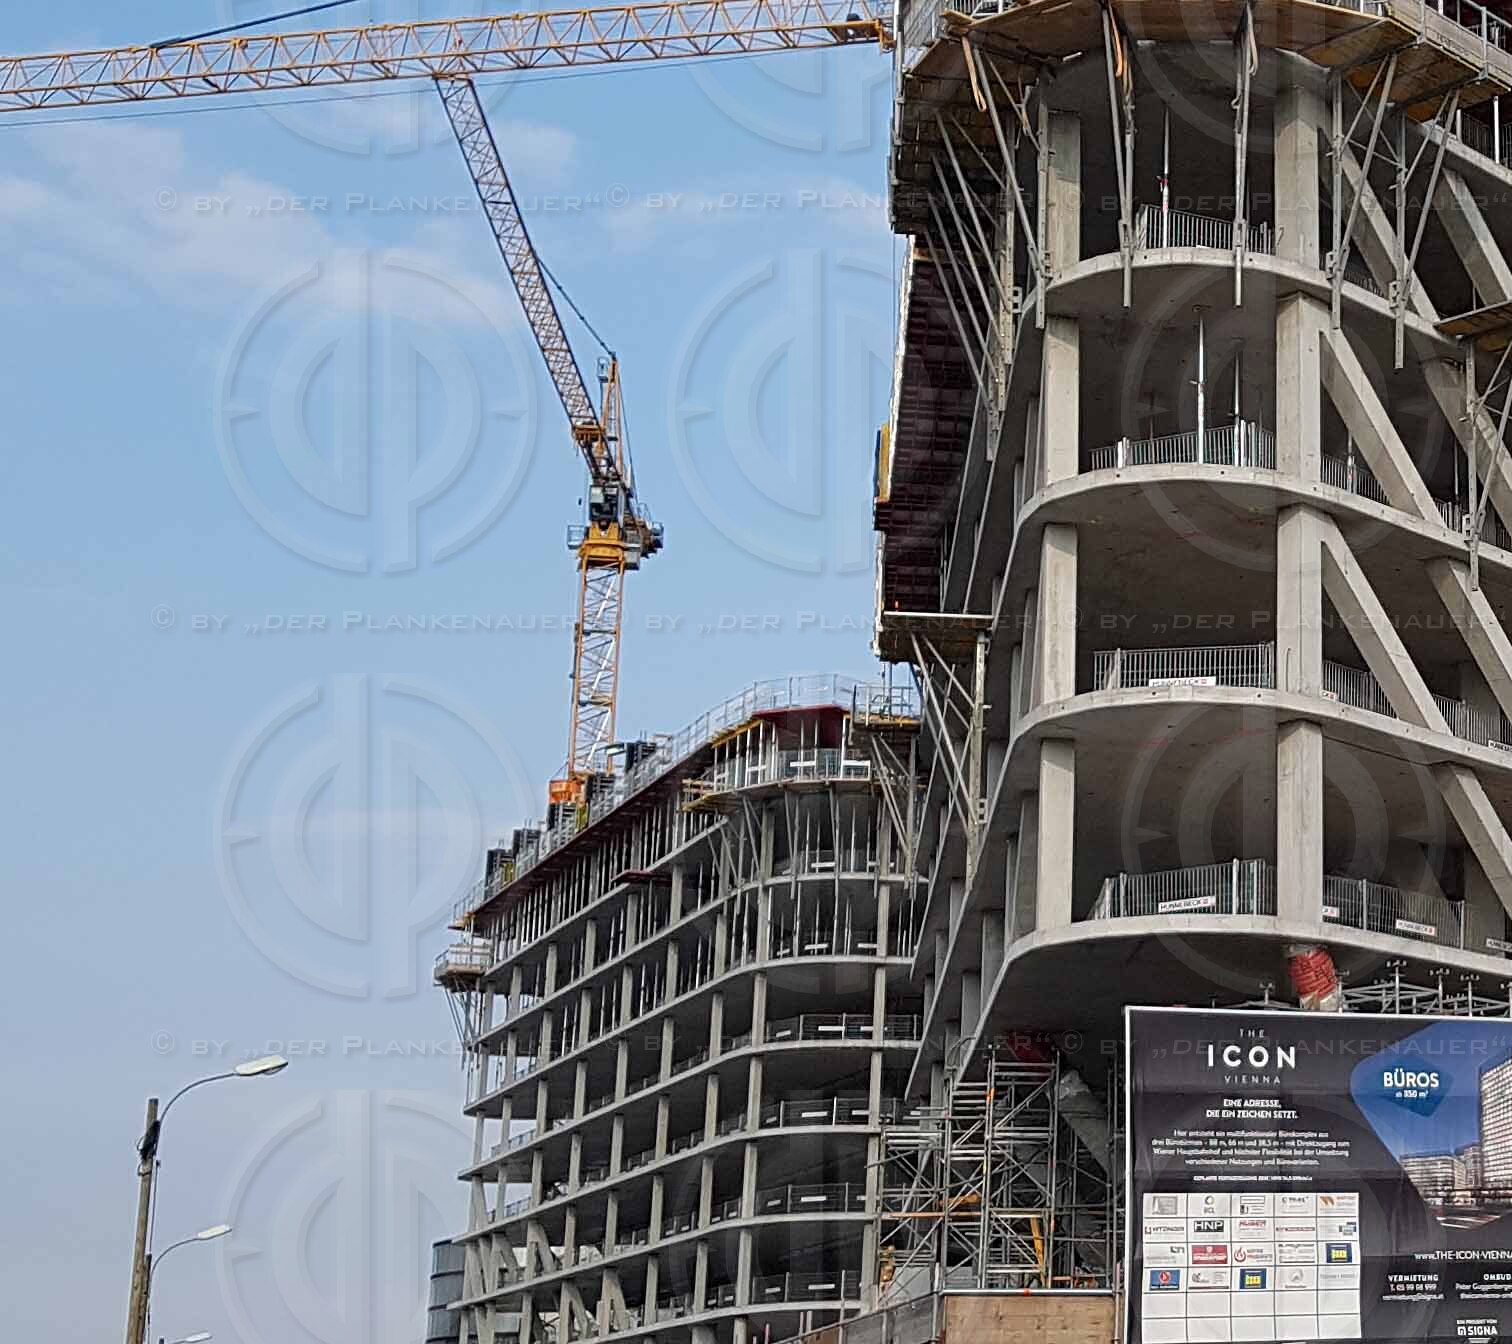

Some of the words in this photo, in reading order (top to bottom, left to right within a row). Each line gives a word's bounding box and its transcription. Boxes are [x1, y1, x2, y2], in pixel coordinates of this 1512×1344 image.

[1239, 1028, 1265, 1038] THE
[1207, 1043, 1296, 1069] ICON
[1224, 1075, 1281, 1085] VIENNA
[1383, 1067, 1440, 1088] BÜROS
[1237, 1110, 1272, 1120] ZEICHEN
[1194, 1220, 1224, 1232] HNP
[1467, 1326, 1498, 1336] SIGNA
